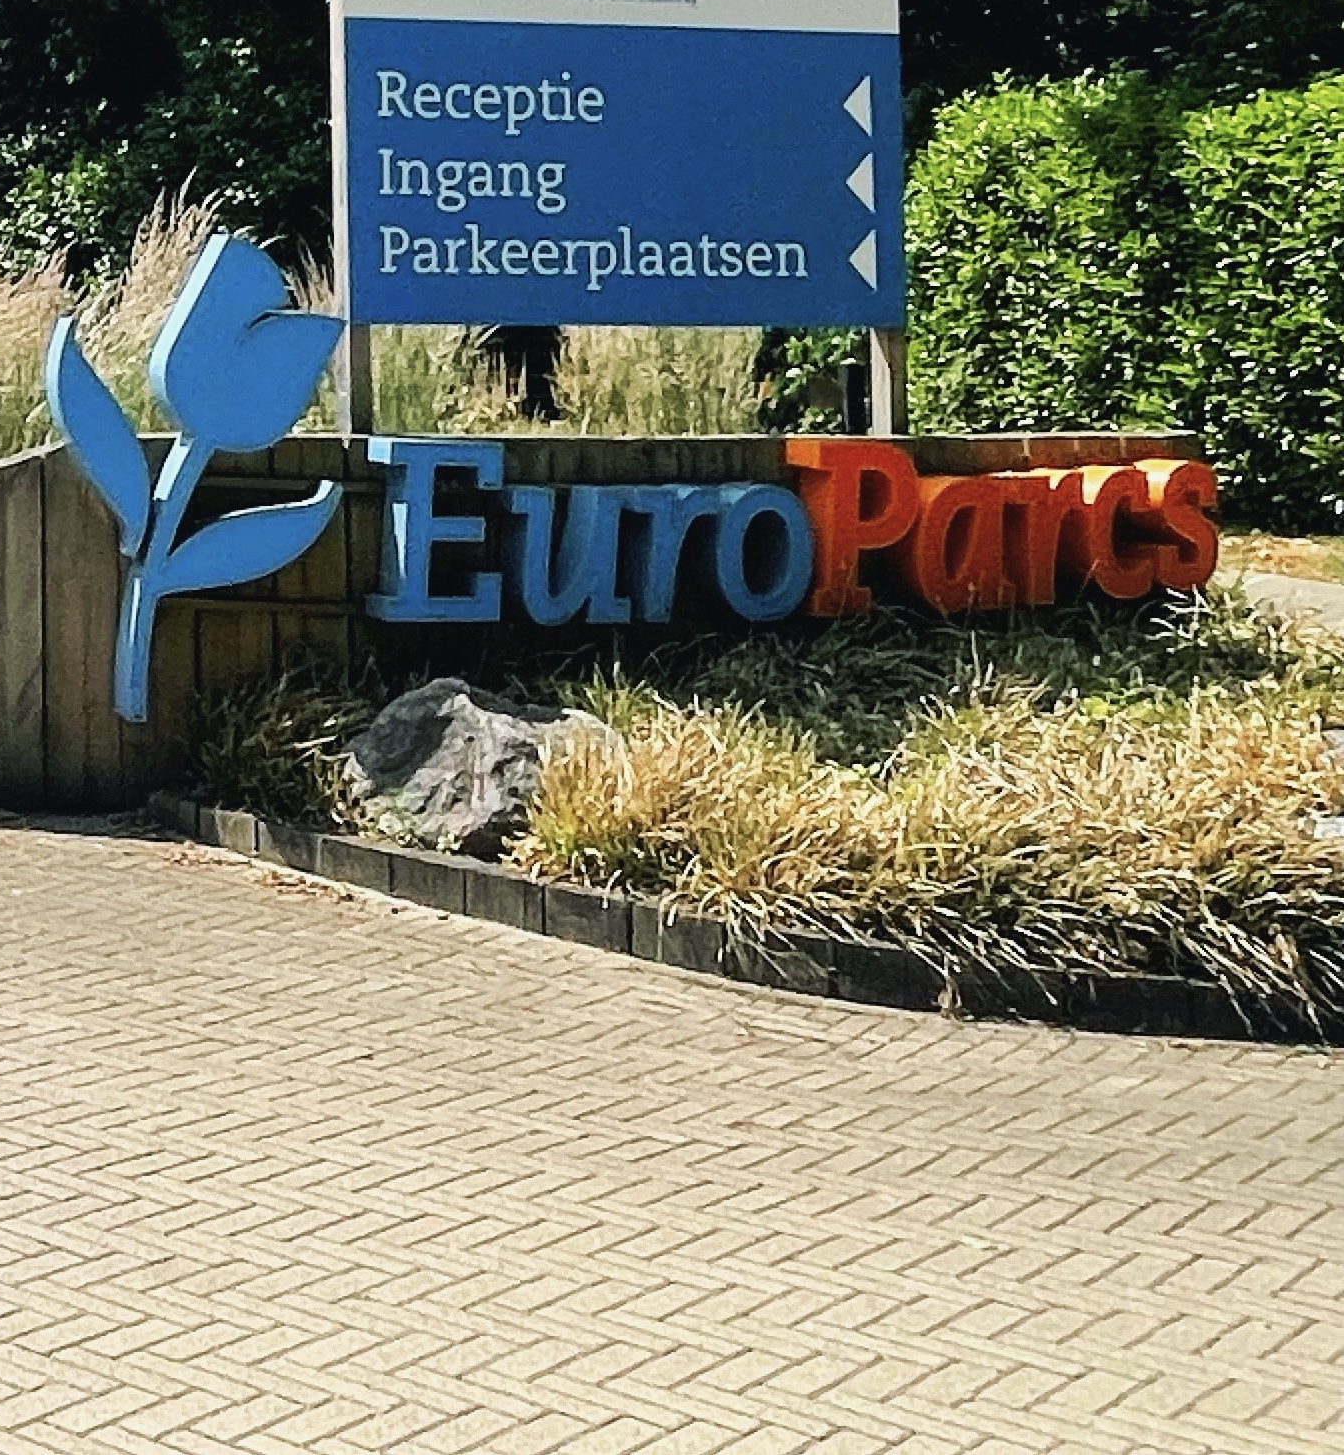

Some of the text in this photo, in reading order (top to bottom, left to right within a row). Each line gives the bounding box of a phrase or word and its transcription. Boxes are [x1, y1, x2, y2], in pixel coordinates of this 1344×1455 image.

[376, 70, 606, 135] Receptie
[377, 148, 567, 214] Ingang
[379, 223, 809, 291] Parkeerplaatsen
[366, 436, 1219, 626] EuroParcs
